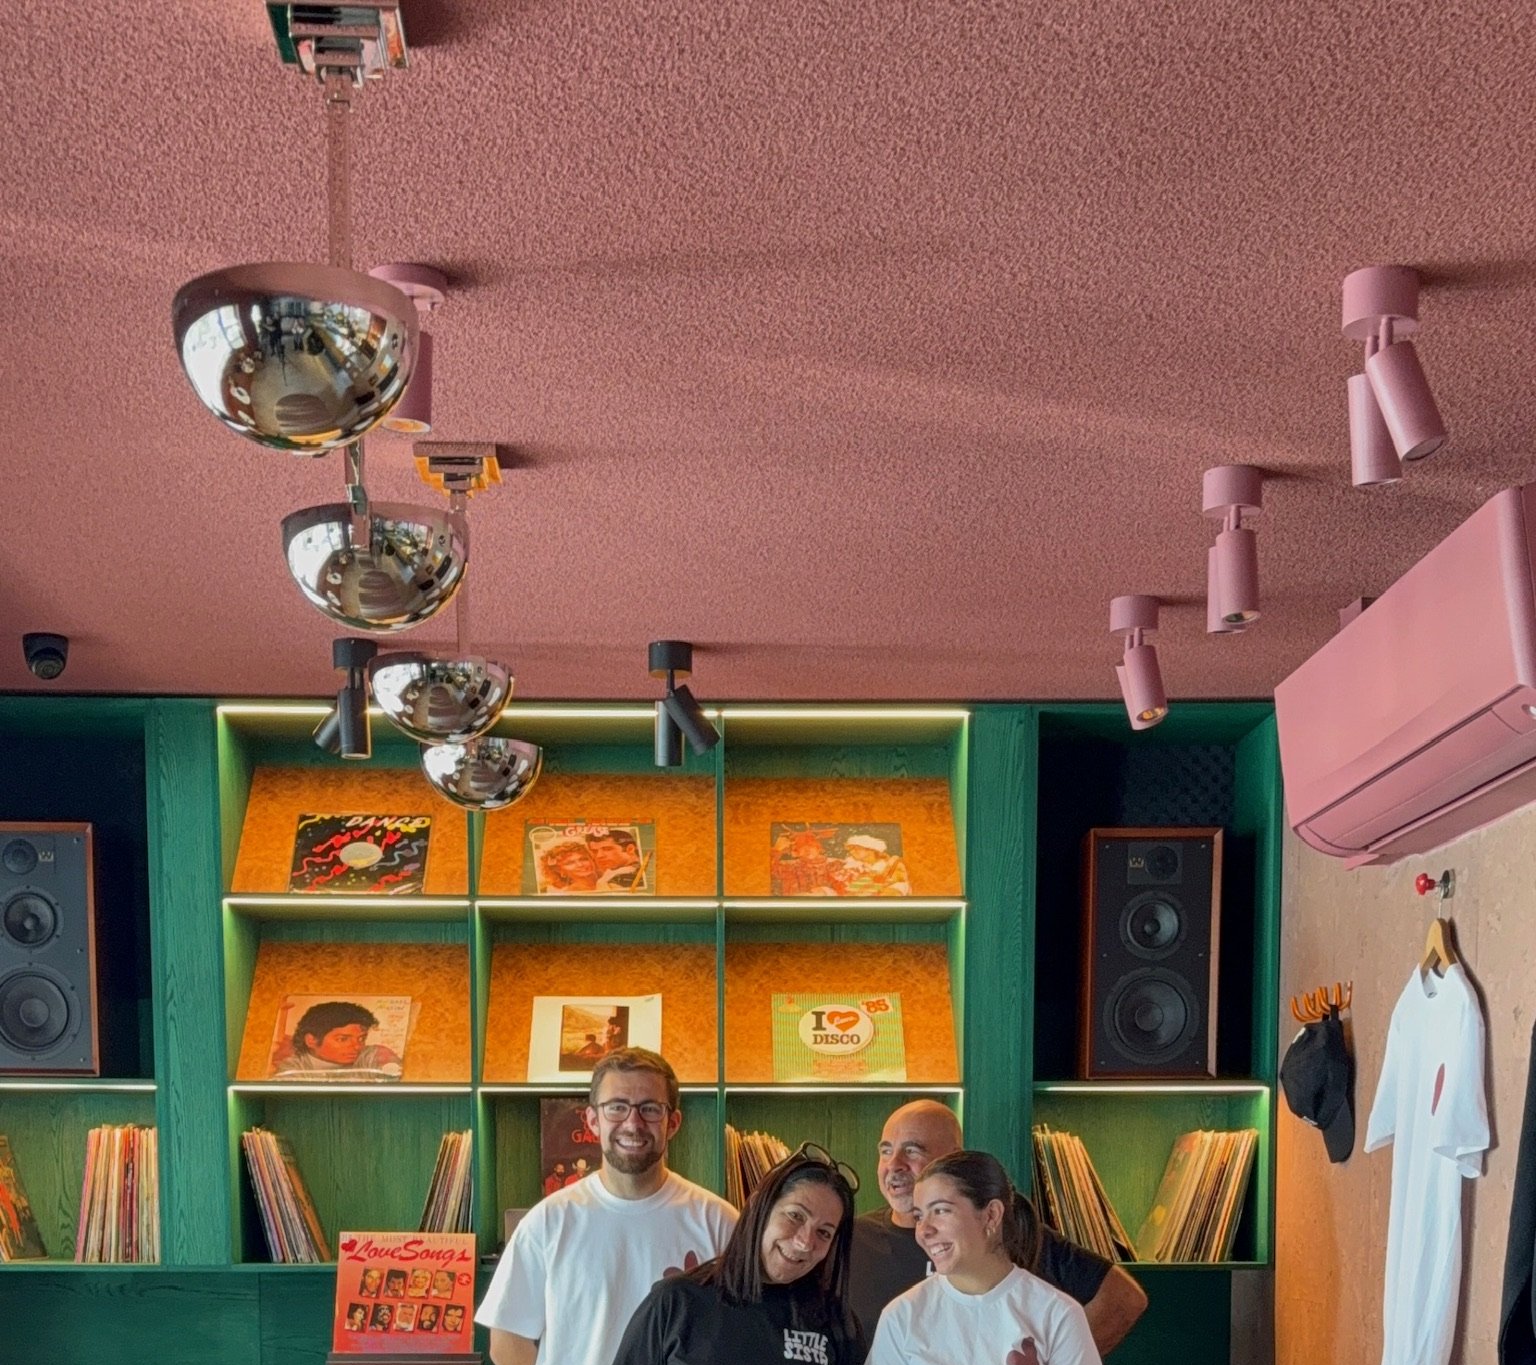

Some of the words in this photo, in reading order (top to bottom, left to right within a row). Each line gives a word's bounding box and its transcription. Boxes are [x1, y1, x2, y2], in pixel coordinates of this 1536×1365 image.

[811, 1011, 827, 1031] I
[812, 1033, 861, 1045] DISCO
[783, 1328, 828, 1352] LITTLE
